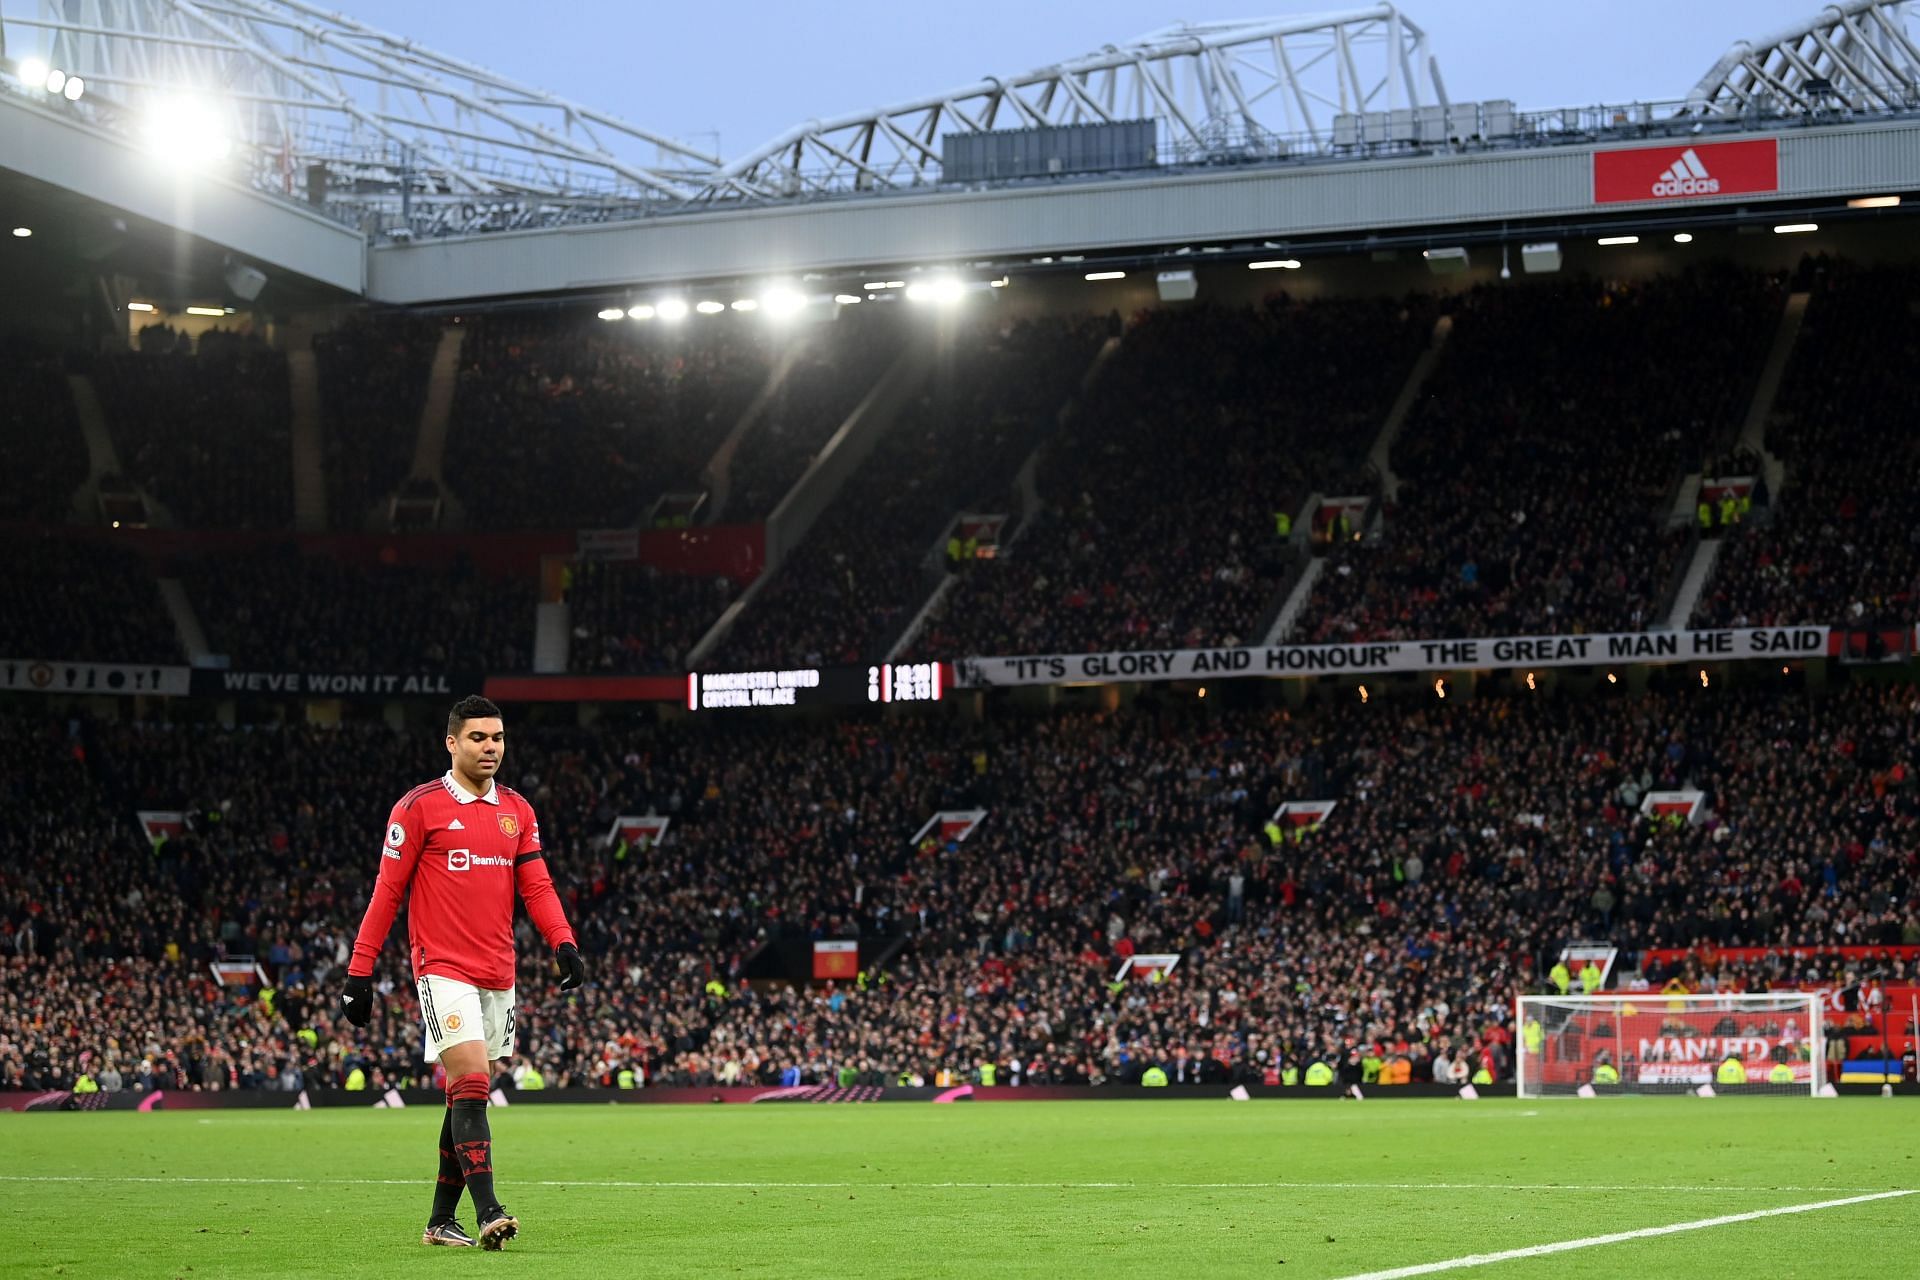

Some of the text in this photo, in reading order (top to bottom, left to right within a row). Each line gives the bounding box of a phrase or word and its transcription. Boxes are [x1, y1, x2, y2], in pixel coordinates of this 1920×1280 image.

[1652, 178, 1720, 197] adidas
[1082, 653, 1176, 676] GLORY
[1191, 650, 1251, 673] AND
[1266, 645, 1400, 670] HONOUR"
[1420, 642, 1478, 664] THE
[1493, 638, 1592, 661] GREAT
[1609, 634, 1678, 657] MAN
[1693, 632, 1733, 654] HE
[1750, 630, 1822, 652] SAID
[223, 672, 450, 693] WE'VE WON IT ALL
